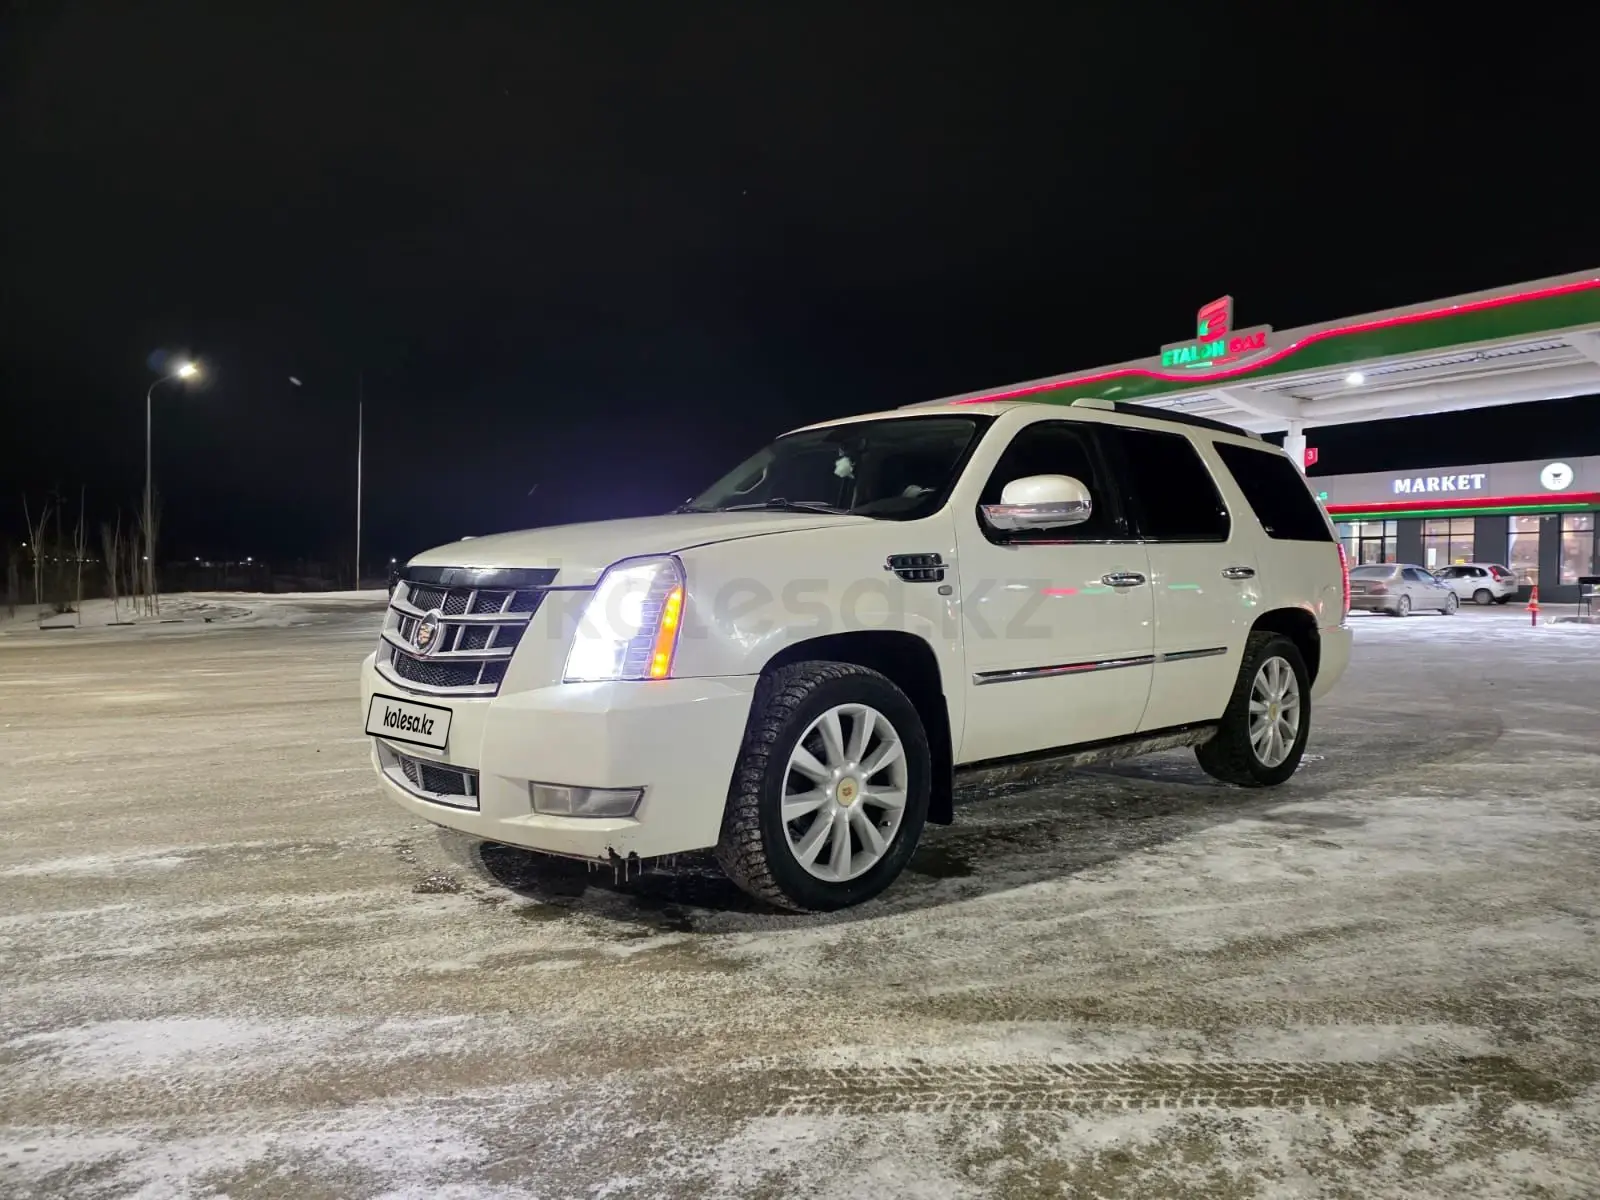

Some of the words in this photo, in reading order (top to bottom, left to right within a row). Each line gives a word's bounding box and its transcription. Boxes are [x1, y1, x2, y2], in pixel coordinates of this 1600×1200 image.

[1162, 340, 1225, 366] ETALON
[1229, 332, 1266, 353] GAZ
[1307, 450, 1313, 460] 3
[1393, 474, 1485, 494] MARKET
